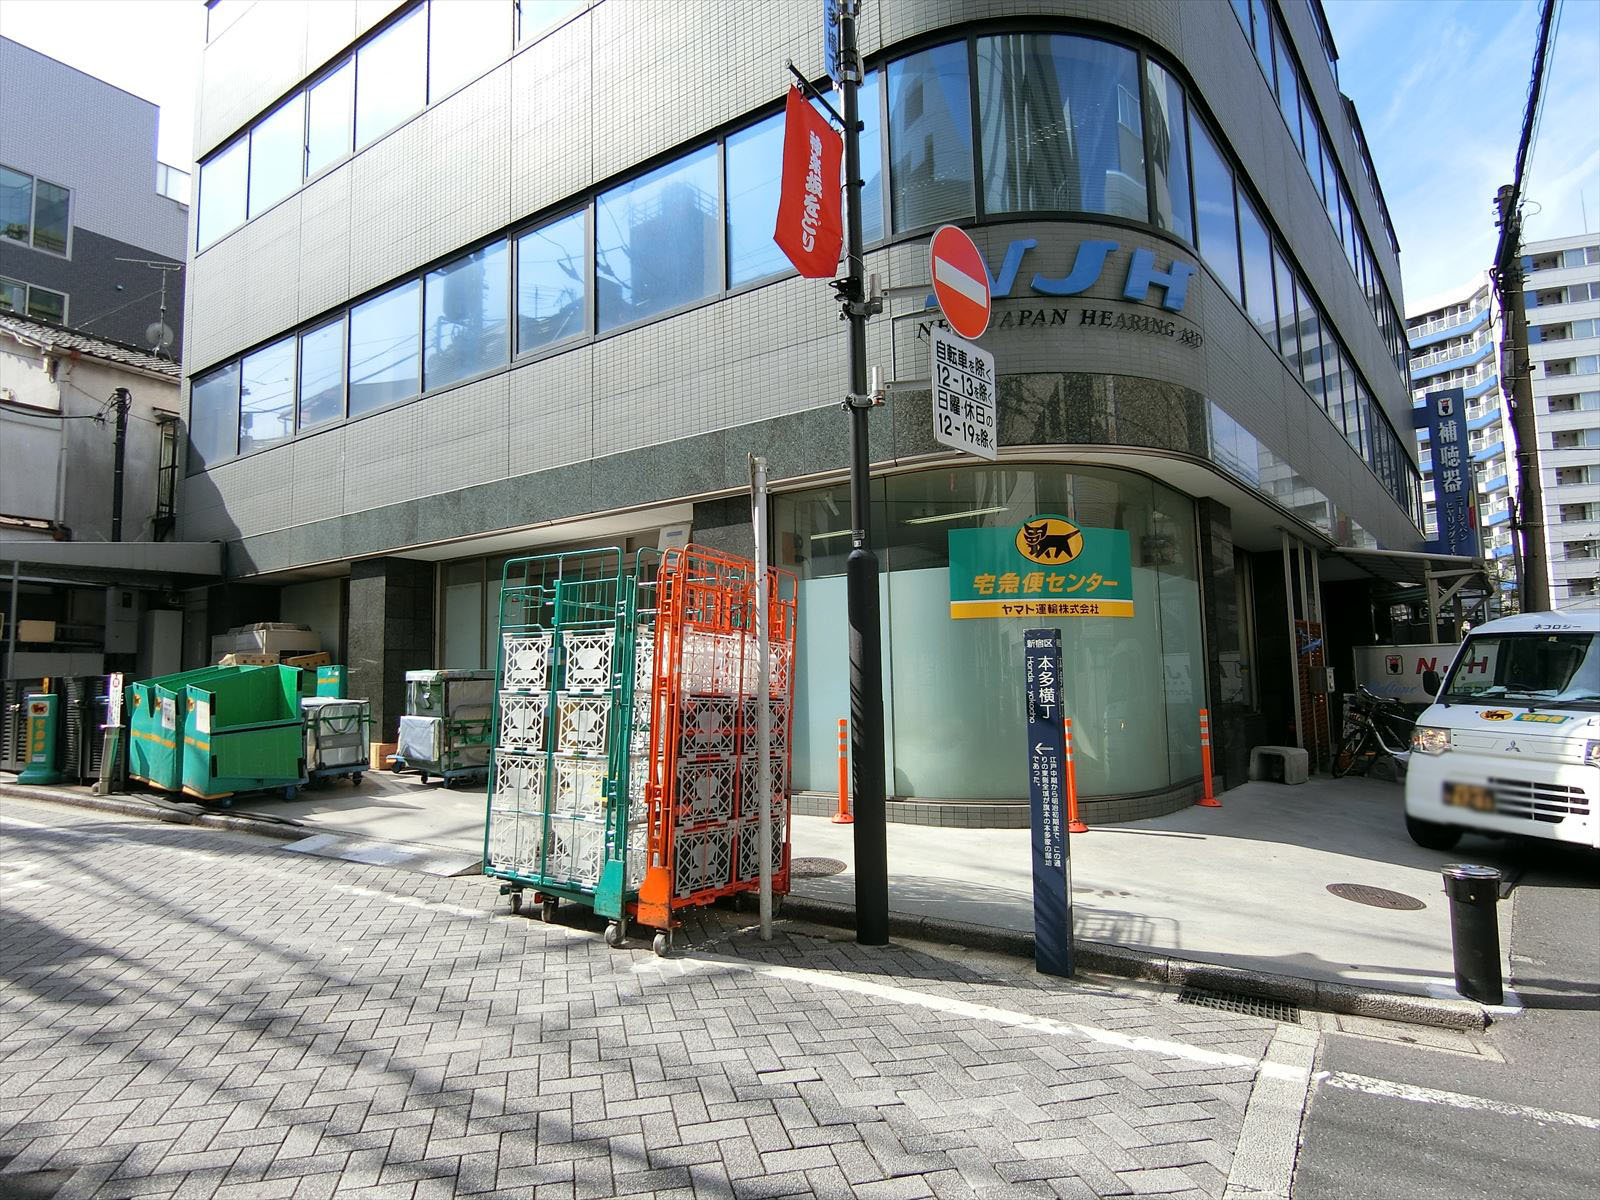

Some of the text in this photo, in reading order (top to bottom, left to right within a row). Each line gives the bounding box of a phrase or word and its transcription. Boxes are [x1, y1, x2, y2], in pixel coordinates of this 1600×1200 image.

[989, 308, 1069, 330] JAPAN
[1080, 308, 1175, 338] HEARING
[937, 340, 992, 381] 自転車を除く
[937, 364, 993, 405] 12-13を除く
[939, 413, 994, 451] 12-19を除く
[1438, 420, 1463, 494] 補聴器
[973, 571, 1118, 595] 宅急便センター
[1002, 603, 1100, 615] ヤマト運輸株式会社
[1026, 638, 1053, 648] 新宿区
[1037, 655, 1056, 719] 本多横丁
